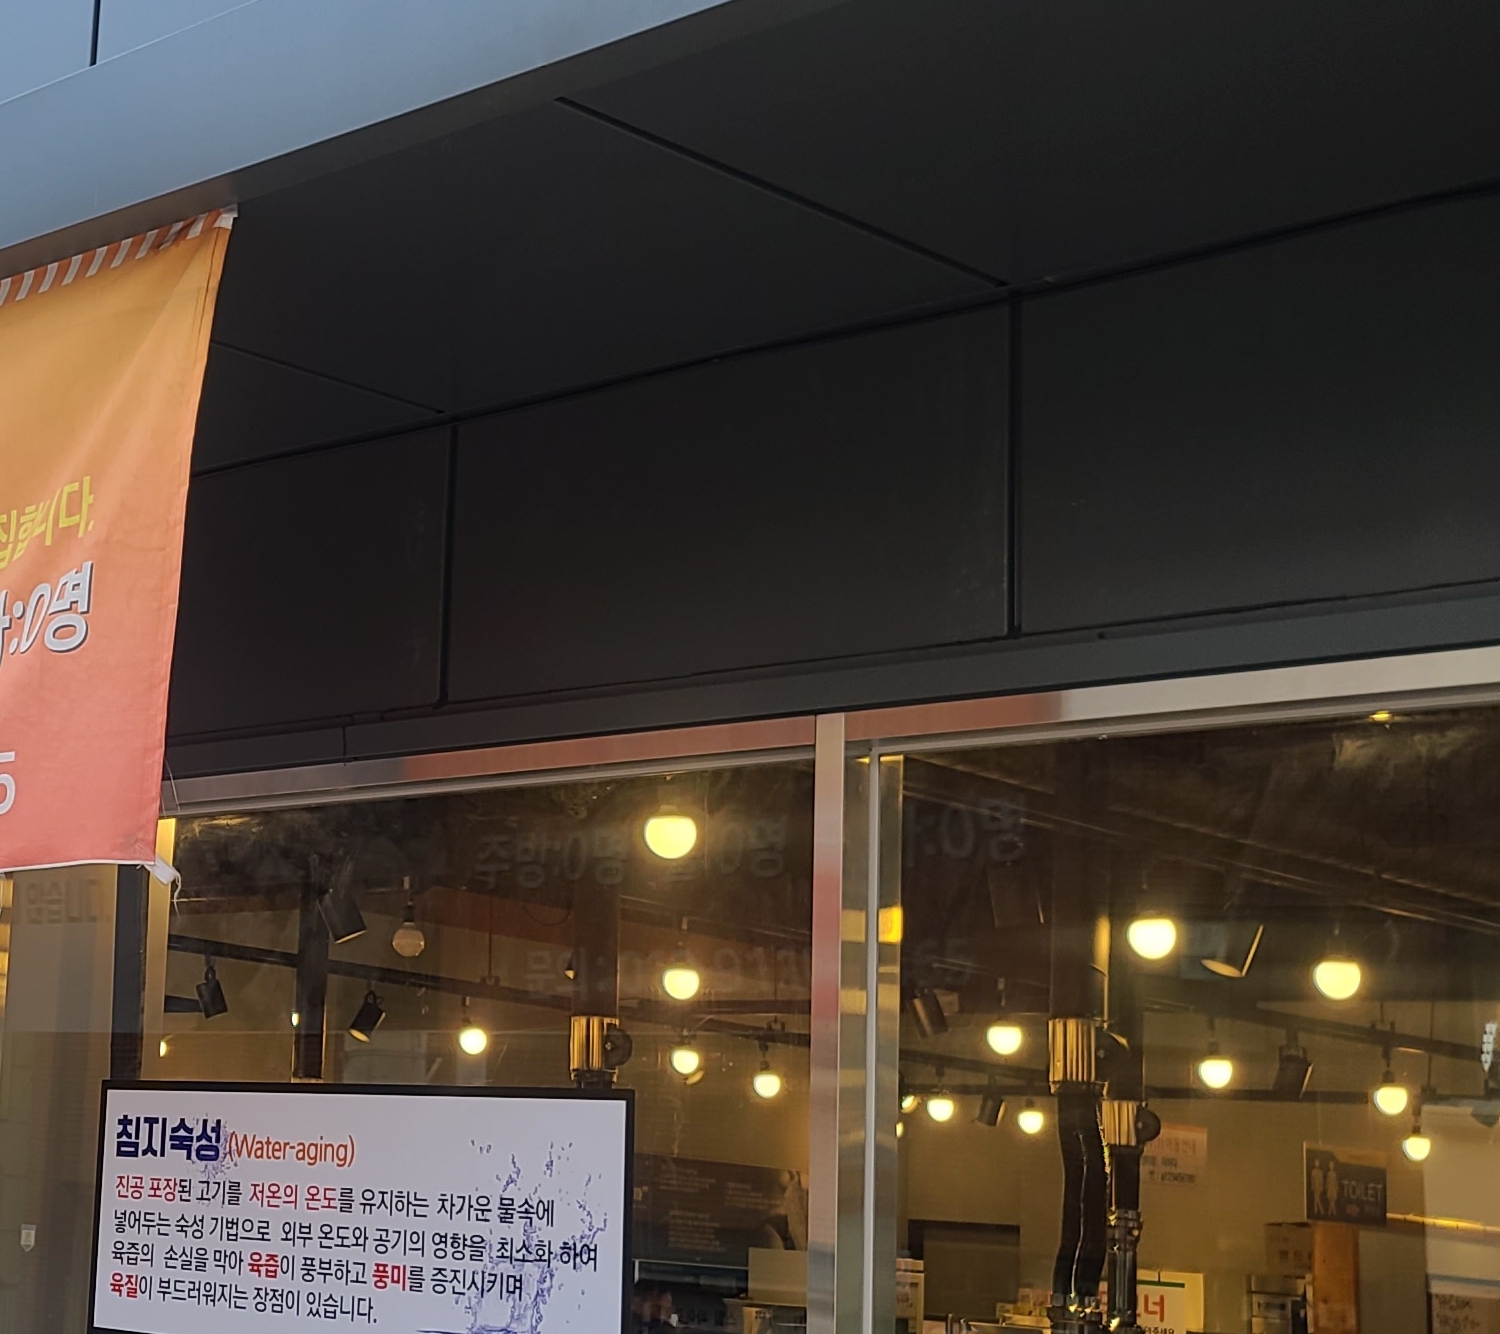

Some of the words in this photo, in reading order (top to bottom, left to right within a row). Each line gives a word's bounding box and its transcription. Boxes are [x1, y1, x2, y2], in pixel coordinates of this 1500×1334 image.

[116, 1114, 222, 1161] 침지숙성
[229, 1132, 356, 1168] (Water-aging)
[115, 1174, 145, 1201] 진공
[148, 1176, 193, 1205] 포장된
[196, 1179, 243, 1208] 고기를
[249, 1182, 298, 1211] 저온의
[304, 1184, 354, 1215] 온도를
[359, 1187, 429, 1221] 유지하는
[437, 1192, 492, 1224] 차가운
[497, 1196, 555, 1227] 물속에
[1341, 1178, 1383, 1202] TOILET
[113, 1208, 170, 1239] 넣어두는
[175, 1210, 204, 1240] 숙성
[210, 1214, 271, 1244] 기법으로
[281, 1219, 312, 1249] 외부
[318, 1222, 368, 1253] 온도와
[373, 1225, 426, 1257] 공기의
[431, 1229, 486, 1263] 영향을
[496, 1235, 553, 1268] 최소화
[560, 1240, 598, 1273] 하여
[111, 1240, 153, 1269] 육즙의
[163, 1244, 209, 1273] 손실을
[213, 1247, 243, 1276] 막아
[248, 1251, 294, 1280] 육즙이
[300, 1255, 367, 1287] 풍부하고
[372, 1259, 426, 1292] 풍미를
[431, 1265, 523, 1303] 증진시키며
[110, 1272, 153, 1302] 육질이
[157, 1276, 248, 1311] 부드러워지는
[253, 1284, 299, 1315] 장점이
[305, 1290, 377, 1325] 있습니다.
